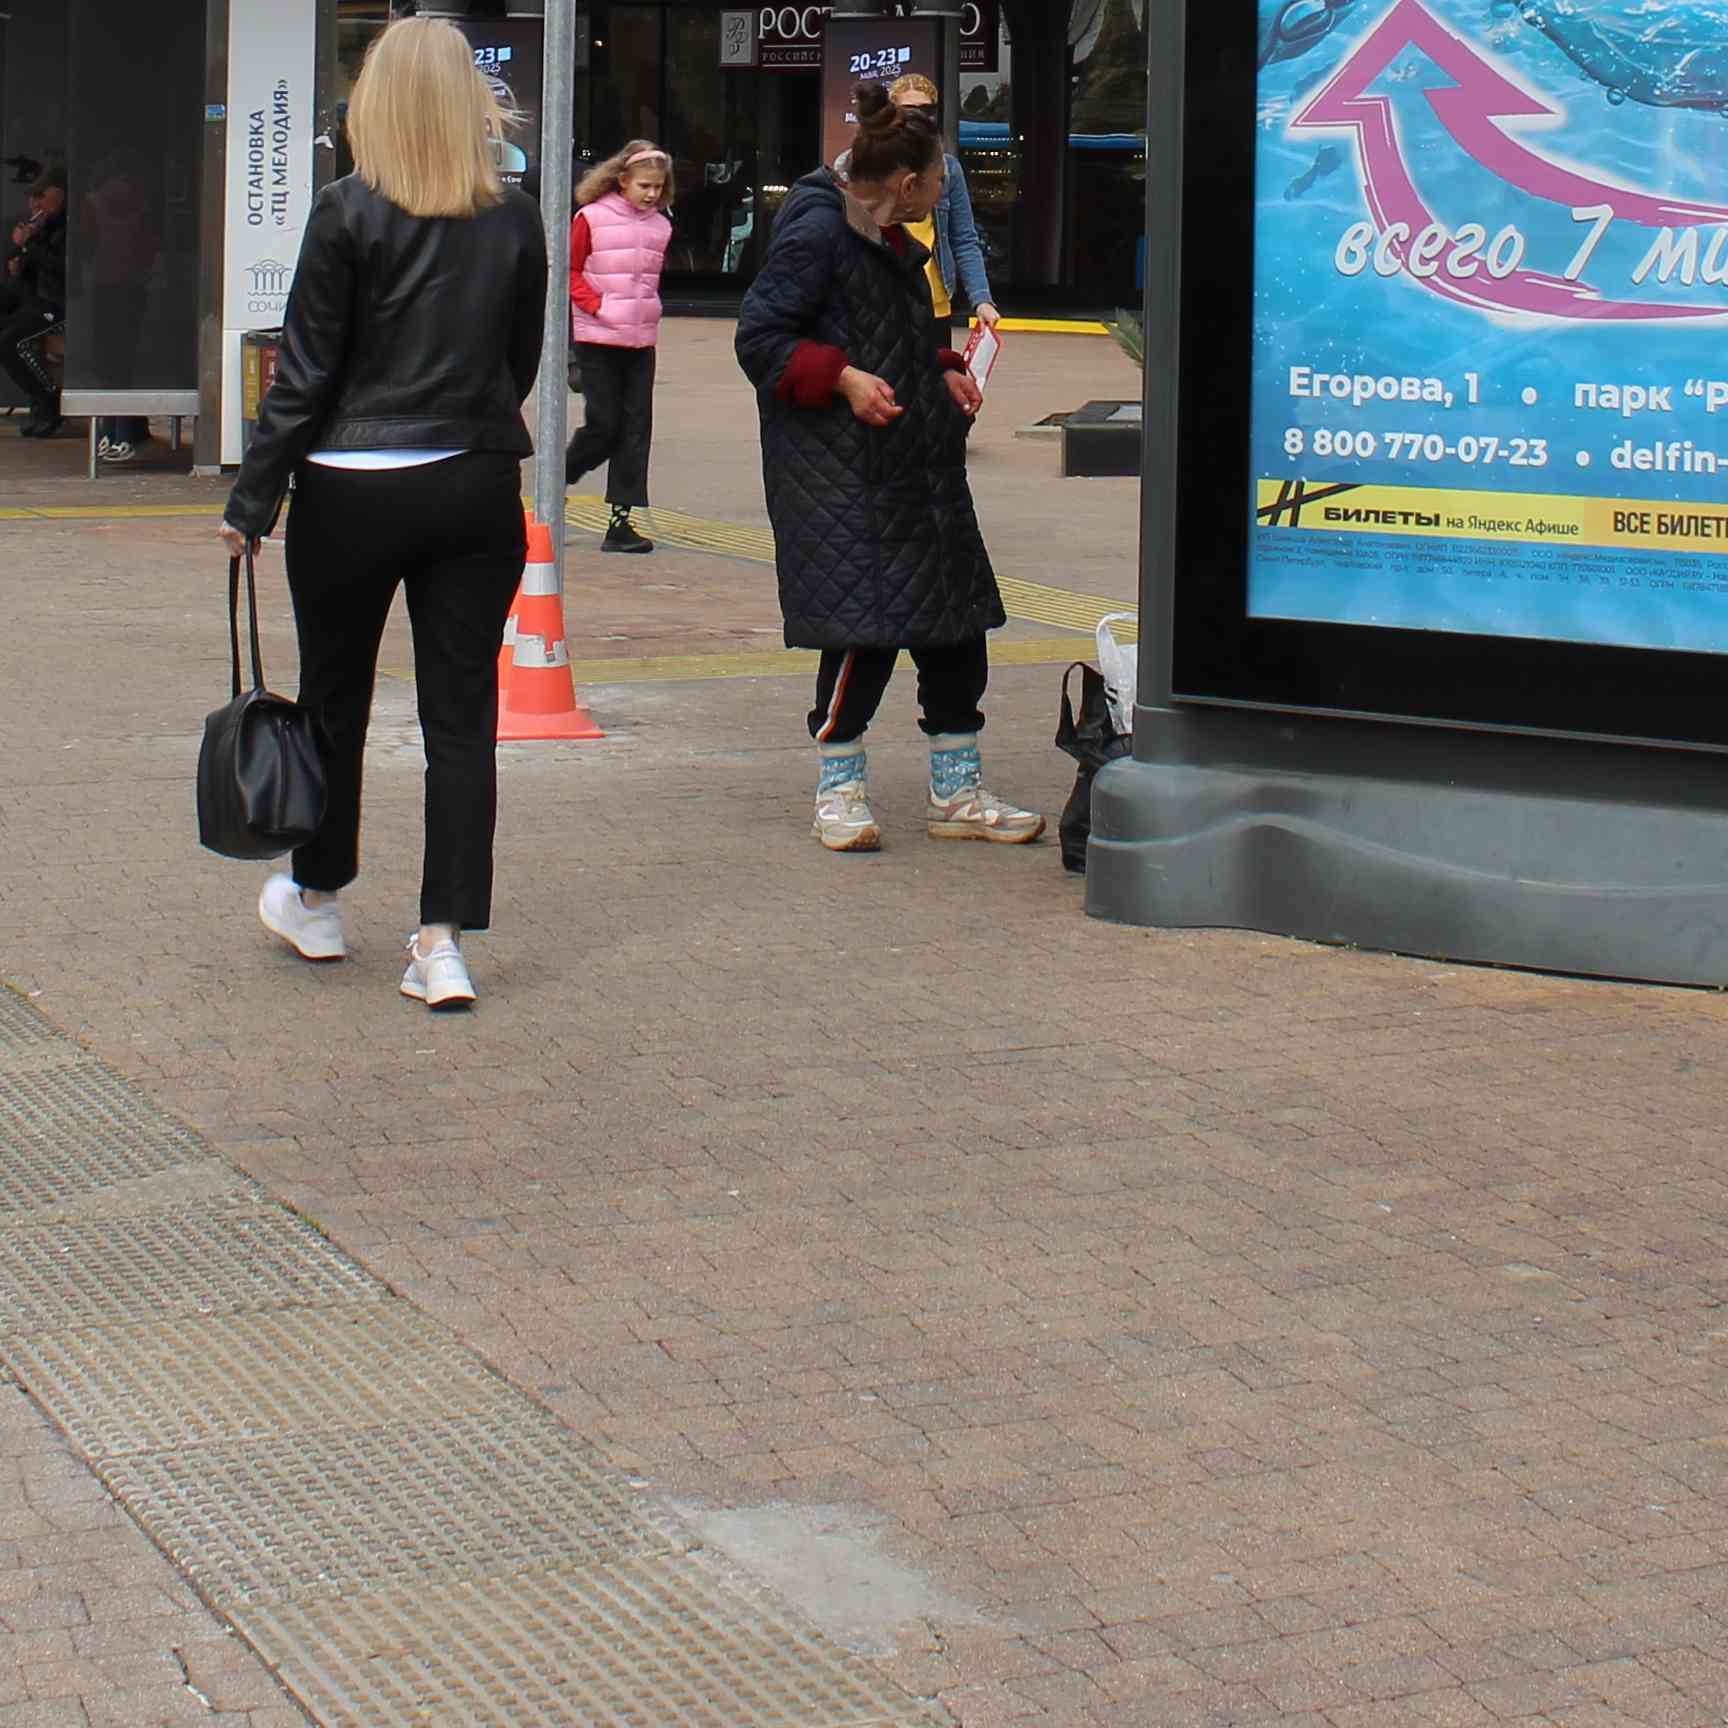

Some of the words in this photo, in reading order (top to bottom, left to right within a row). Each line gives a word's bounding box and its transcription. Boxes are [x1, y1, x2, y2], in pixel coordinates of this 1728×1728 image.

[849, 47, 897, 73] 20-23
[272, 79, 292, 186] МЕЛОДИЯ»
[248, 109, 266, 226] ОСТАНОВКА
[1333, 222, 1526, 279] всего
[1563, 204, 1615, 281] 7
[1288, 366, 1454, 410] Егорова,
[1463, 372, 1480, 403] 1
[1574, 382, 1672, 424] парк
[1284, 427, 1305, 458] 8
[1312, 428, 1377, 460] 800
[1384, 431, 1549, 469] 770-07-23
[1323, 508, 1441, 530] БИЛЕТЫ
[1445, 517, 1464, 532] на
[1467, 512, 1523, 537] Яндекс
[1524, 516, 1581, 541] Афише
[1612, 509, 1653, 537] ВСЕ
